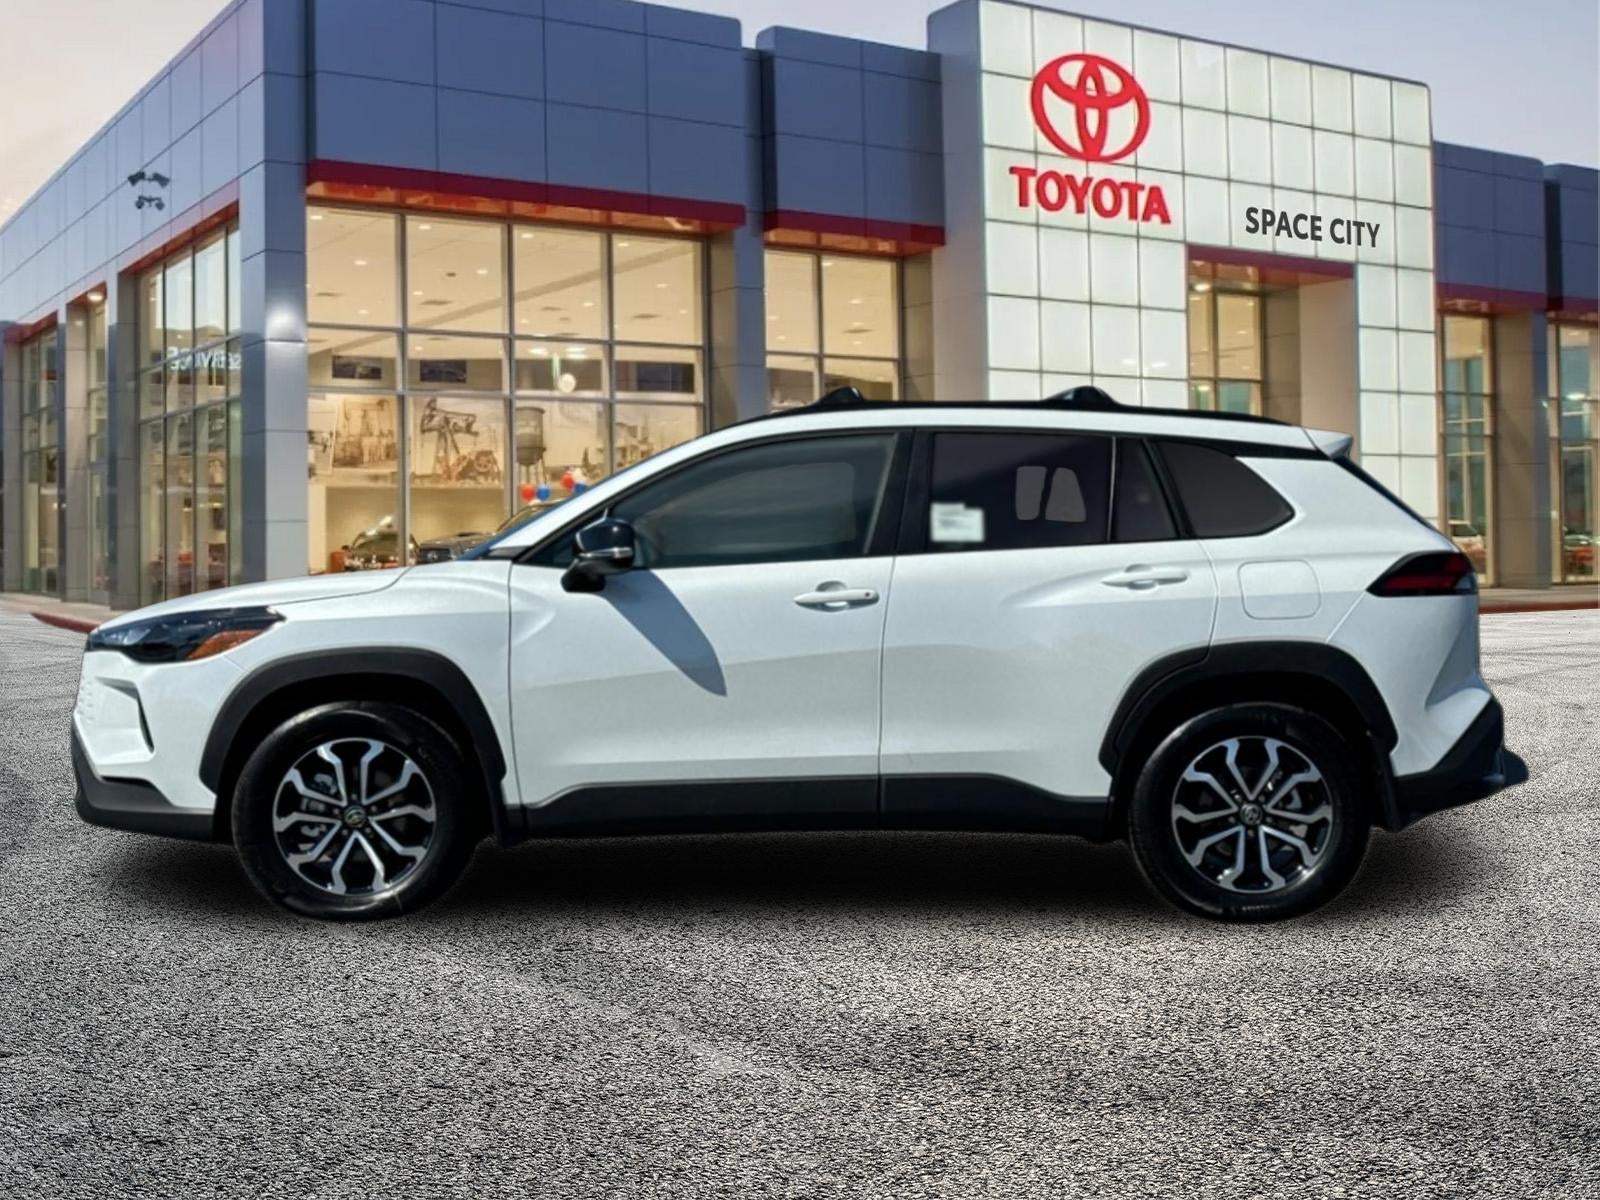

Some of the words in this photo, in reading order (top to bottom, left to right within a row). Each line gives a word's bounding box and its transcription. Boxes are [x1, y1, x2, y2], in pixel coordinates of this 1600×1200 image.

[1009, 166, 1171, 225] TOYOTA
[1244, 206, 1322, 242] SPACE
[1329, 217, 1381, 248] CITY
